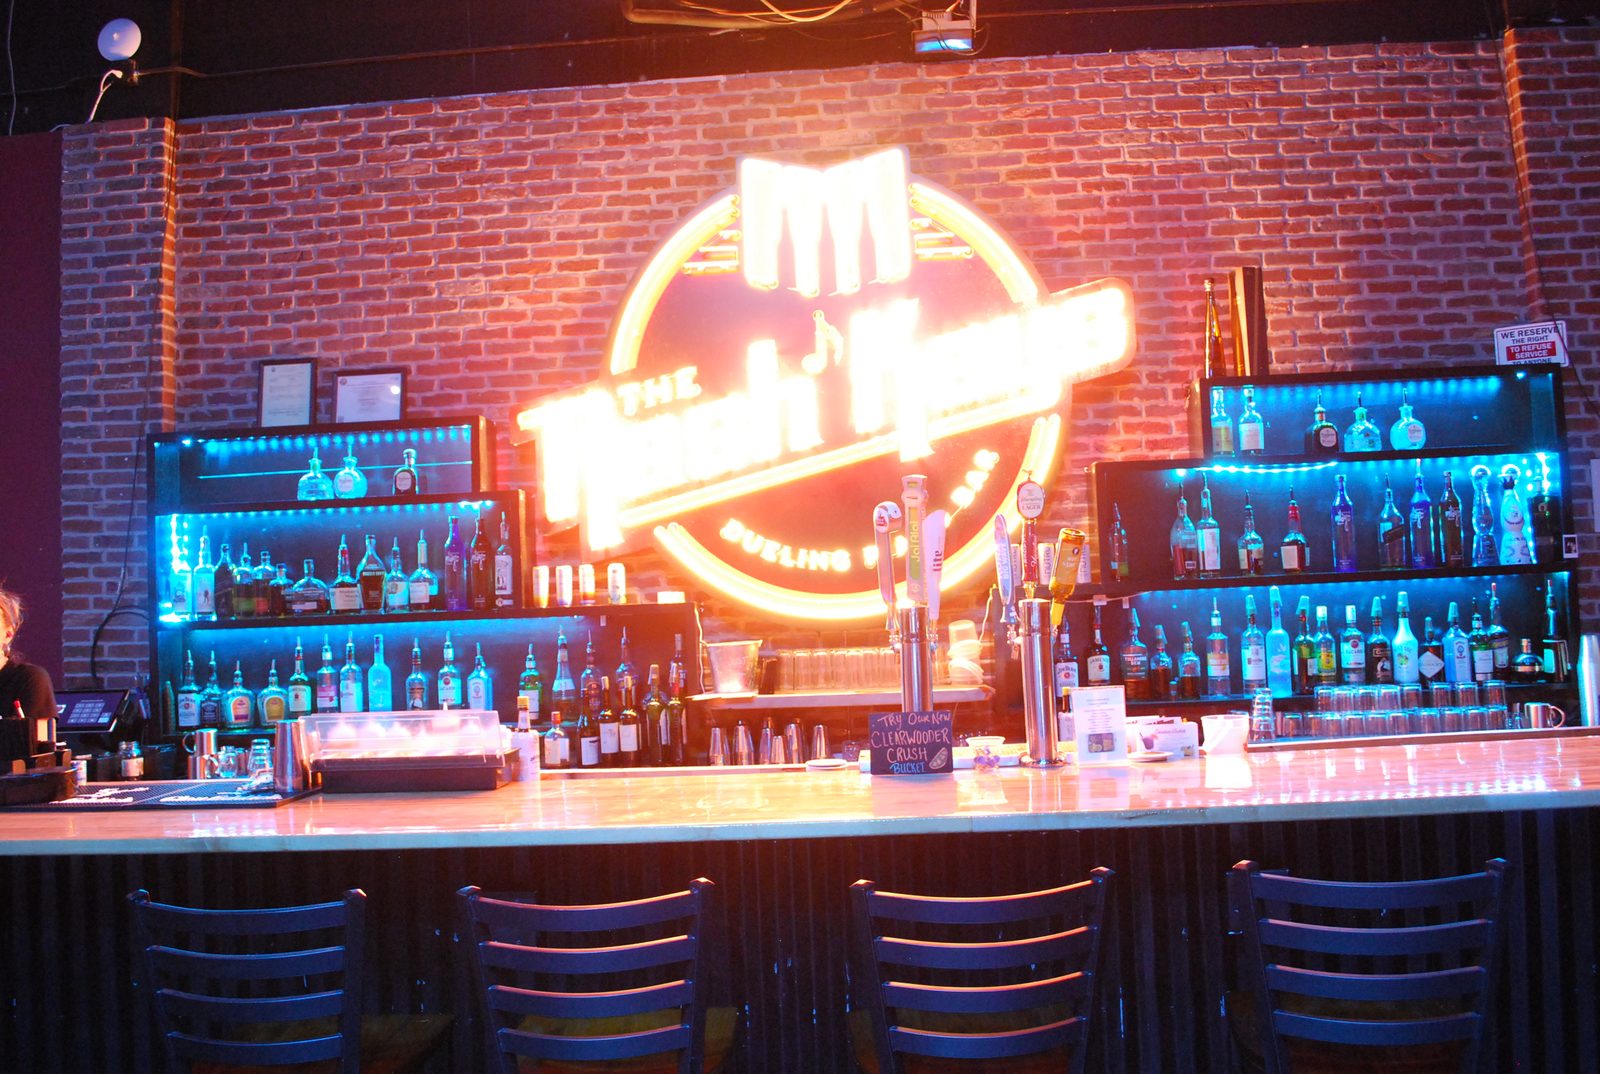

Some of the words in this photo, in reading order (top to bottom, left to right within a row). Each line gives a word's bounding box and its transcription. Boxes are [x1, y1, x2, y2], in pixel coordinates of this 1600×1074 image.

[1501, 330, 1515, 340] WE
[1517, 326, 1560, 337] RESERVE
[1526, 335, 1550, 343] RIGHT
[1514, 350, 1549, 360] SERVICE
[1521, 342, 1553, 352] REFUSE
[616, 366, 702, 417] THE
[719, 517, 852, 572] DUELING
[932, 550, 943, 573] lite
[870, 727, 951, 749] CLEARWOODER
[886, 746, 928, 764] CRUSH
[889, 761, 926, 774] BUCKET
